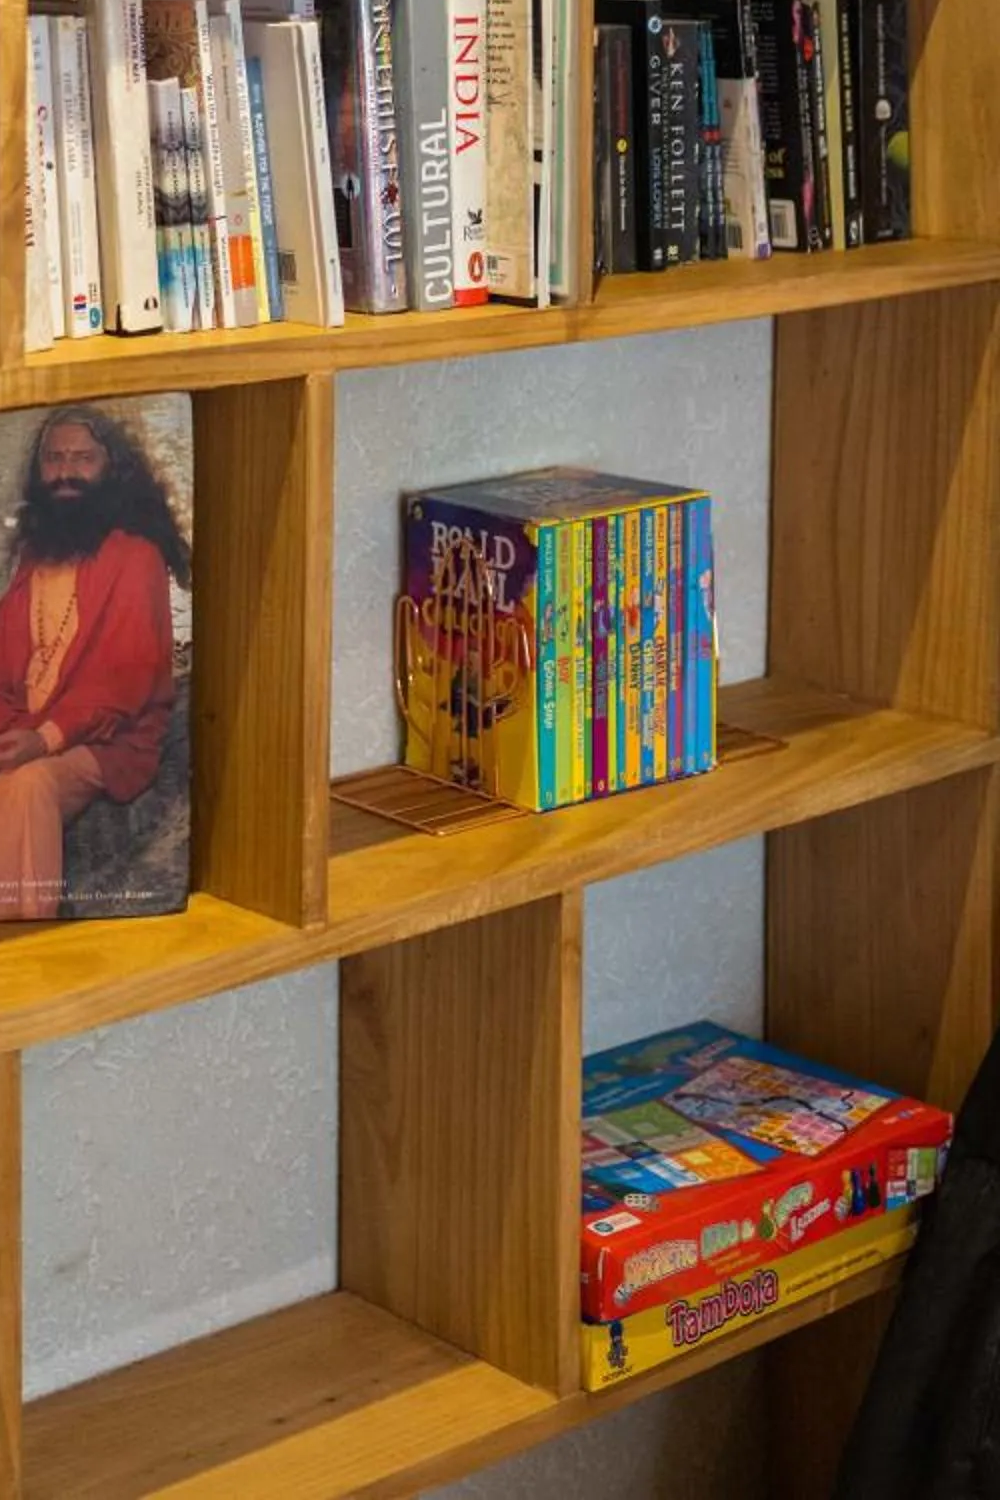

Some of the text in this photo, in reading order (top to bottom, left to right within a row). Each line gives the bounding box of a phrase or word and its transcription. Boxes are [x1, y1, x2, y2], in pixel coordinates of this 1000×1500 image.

[454, 15, 483, 156] INDIA
[649, 54, 662, 126] GIVER
[670, 61, 685, 234] KEN FOLLETT
[380, 162, 403, 272] FOWL
[421, 107, 453, 305] CULTURAL
[430, 521, 516, 569] ROALD
[666, 1267, 779, 1348] Tambola
